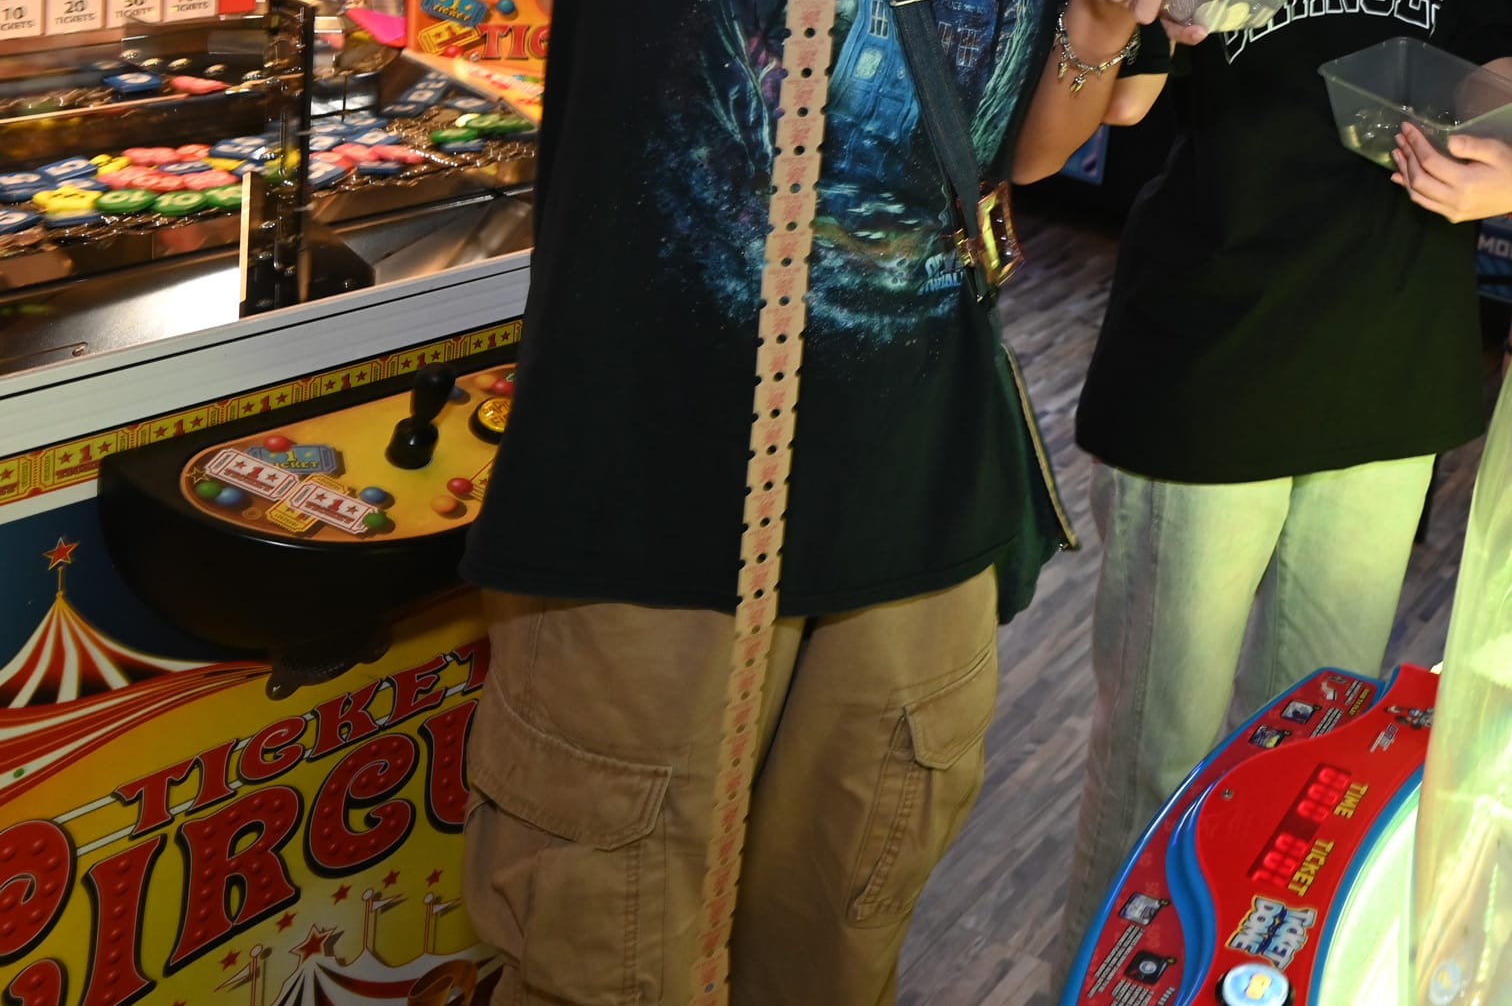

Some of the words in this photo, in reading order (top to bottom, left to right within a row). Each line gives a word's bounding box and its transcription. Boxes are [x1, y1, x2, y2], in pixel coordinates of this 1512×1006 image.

[64, 0, 86, 13] 20
[1332, 782, 1369, 820] TIME
[1287, 837, 1336, 898] TICKET
[1228, 896, 1285, 954] DOME
[1262, 908, 1317, 971] TICKET
